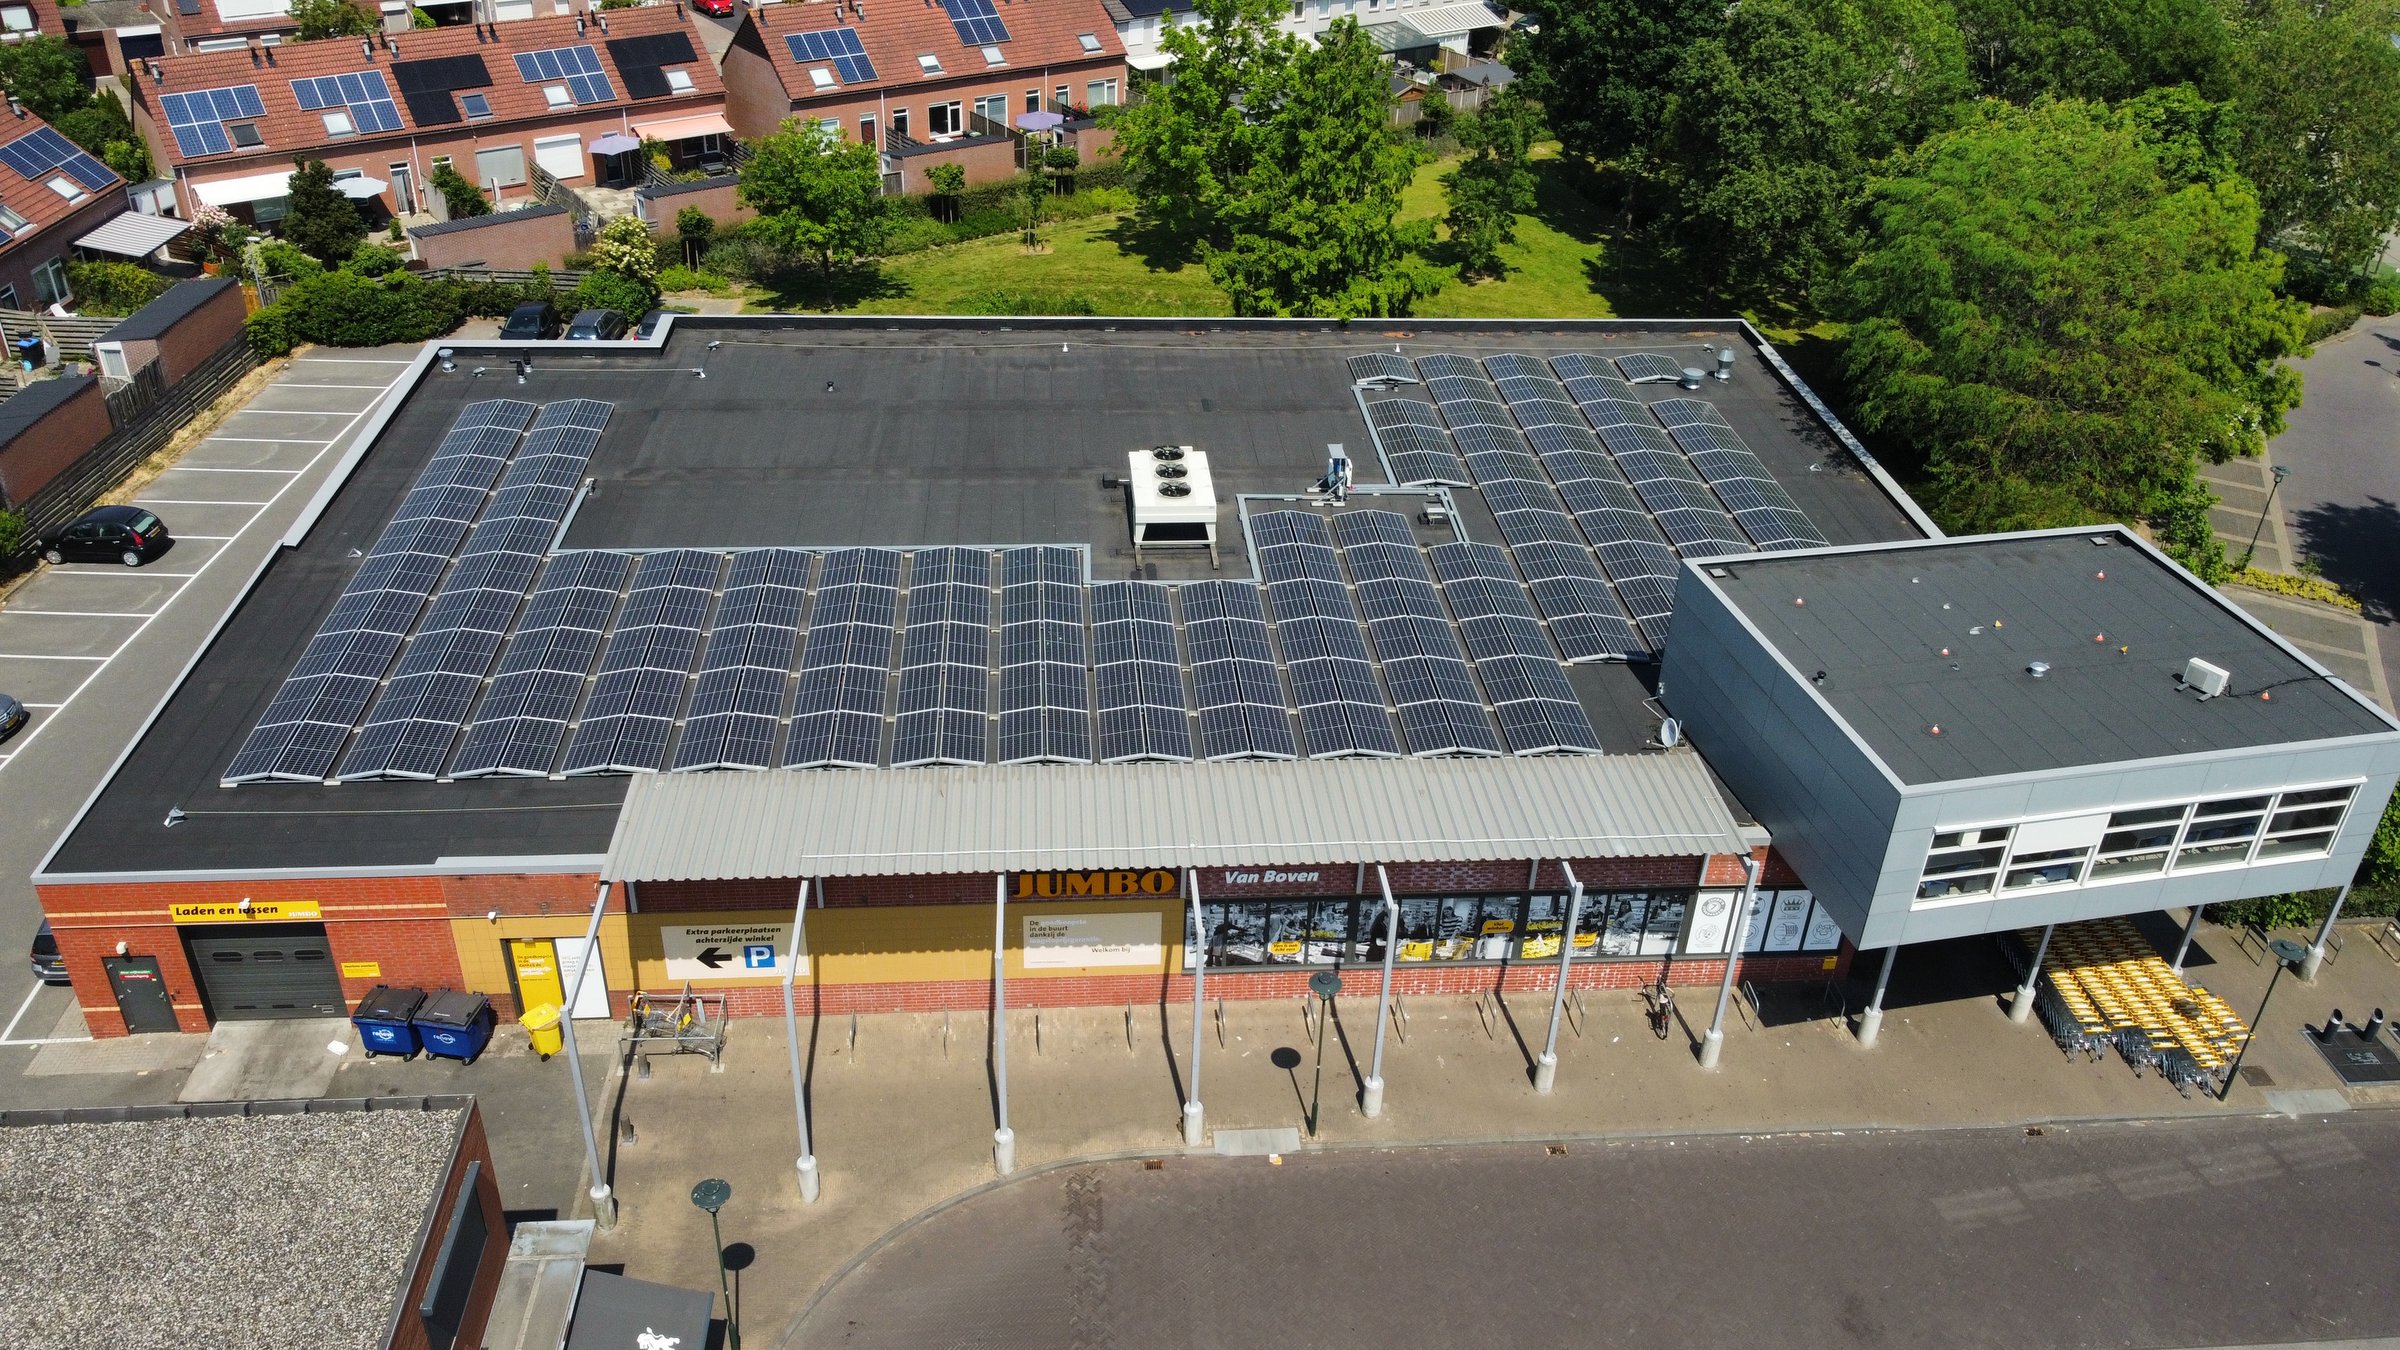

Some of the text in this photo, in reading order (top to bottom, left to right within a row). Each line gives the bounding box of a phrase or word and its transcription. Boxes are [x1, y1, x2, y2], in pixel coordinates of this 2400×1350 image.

[1225, 870, 1319, 884] Van Boven
[1012, 870, 1175, 898] JUMBO
[175, 905, 278, 916] Laden en lossen
[686, 927, 781, 937] Extra parkeerplaatsen
[1029, 931, 1056, 939] dankzij
[695, 936, 743, 944] achterzijde
[1121, 946, 1131, 954] bij
[750, 946, 771, 967] P
